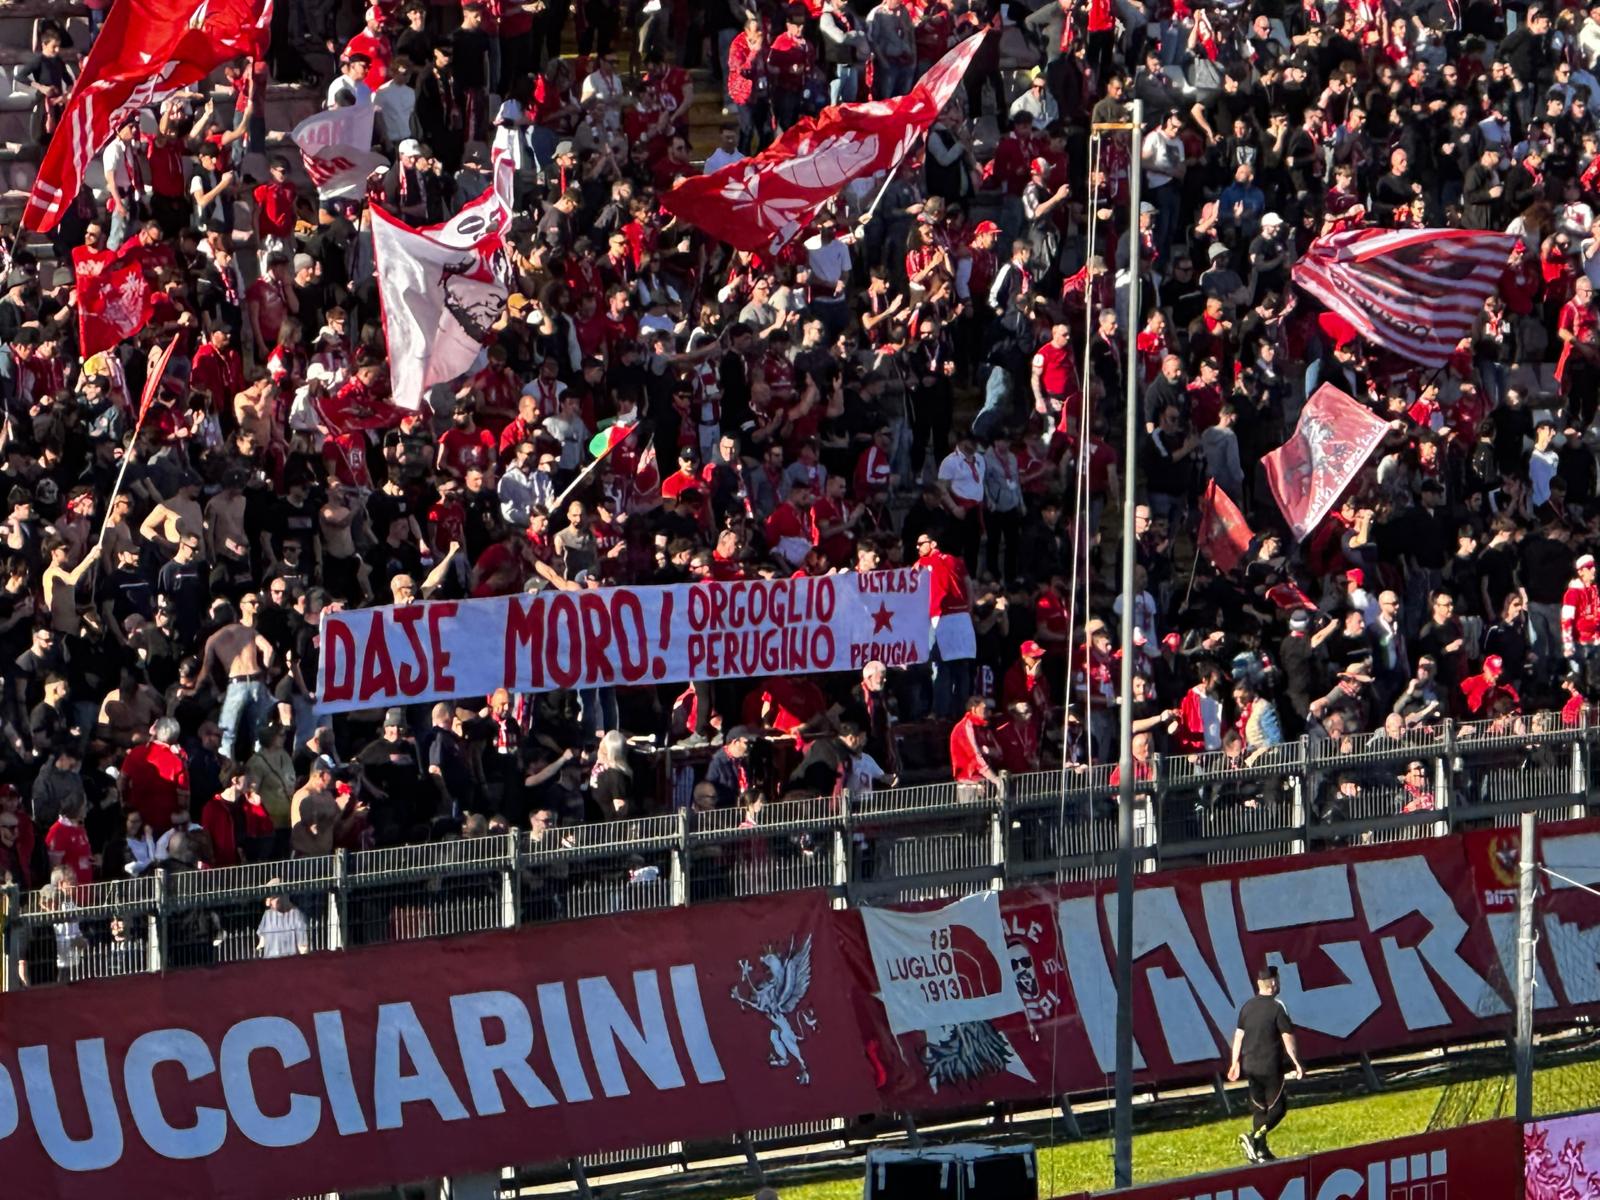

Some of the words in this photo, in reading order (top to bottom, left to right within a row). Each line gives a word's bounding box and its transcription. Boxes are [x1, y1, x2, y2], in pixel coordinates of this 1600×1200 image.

[858, 569, 919, 594] ULTRAS
[688, 576, 836, 632] ORGOGLIO
[323, 602, 459, 703] DAJE
[504, 588, 674, 689] MORO!
[688, 624, 836, 678] PERUGINO
[850, 639, 919, 669] PERUGIA
[930, 928, 951, 951] 15
[886, 952, 954, 981] LUGLIO
[920, 978, 961, 1003] 1913
[0, 963, 726, 1172] UCCIARINI
